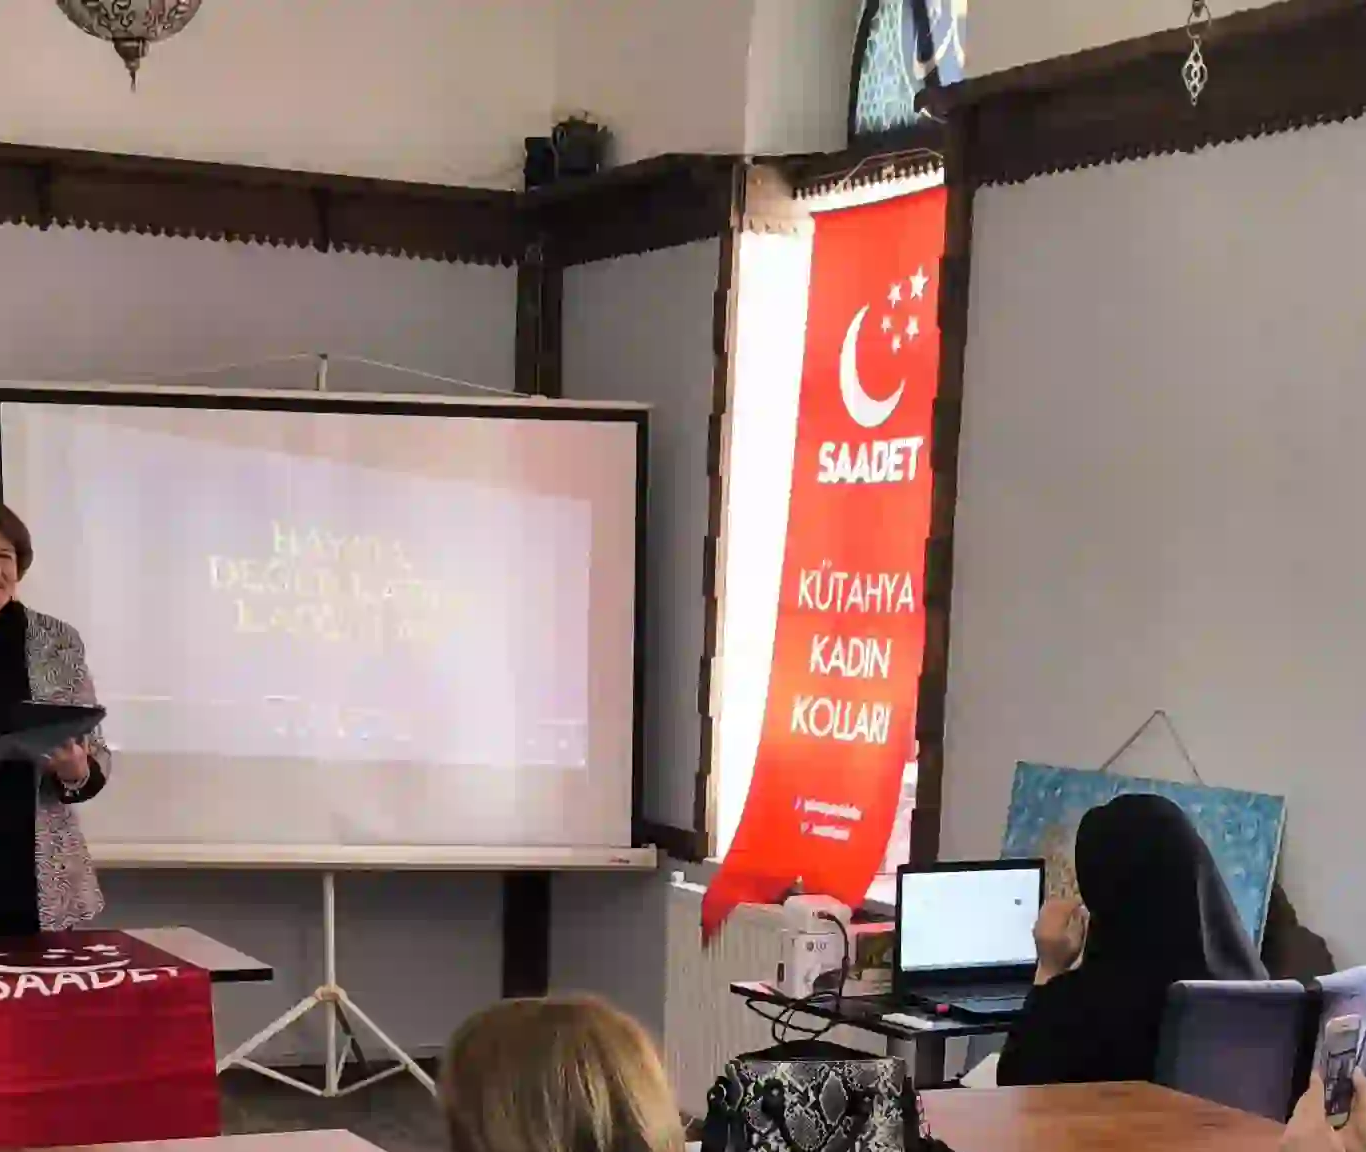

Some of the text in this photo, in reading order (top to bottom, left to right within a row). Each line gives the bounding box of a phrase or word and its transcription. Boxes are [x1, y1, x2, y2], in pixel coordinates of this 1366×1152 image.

[817, 436, 924, 484] SAADET
[798, 559, 915, 613] KÜTAHYA
[809, 634, 892, 679] KADIN
[791, 695, 892, 745] KOLLARI
